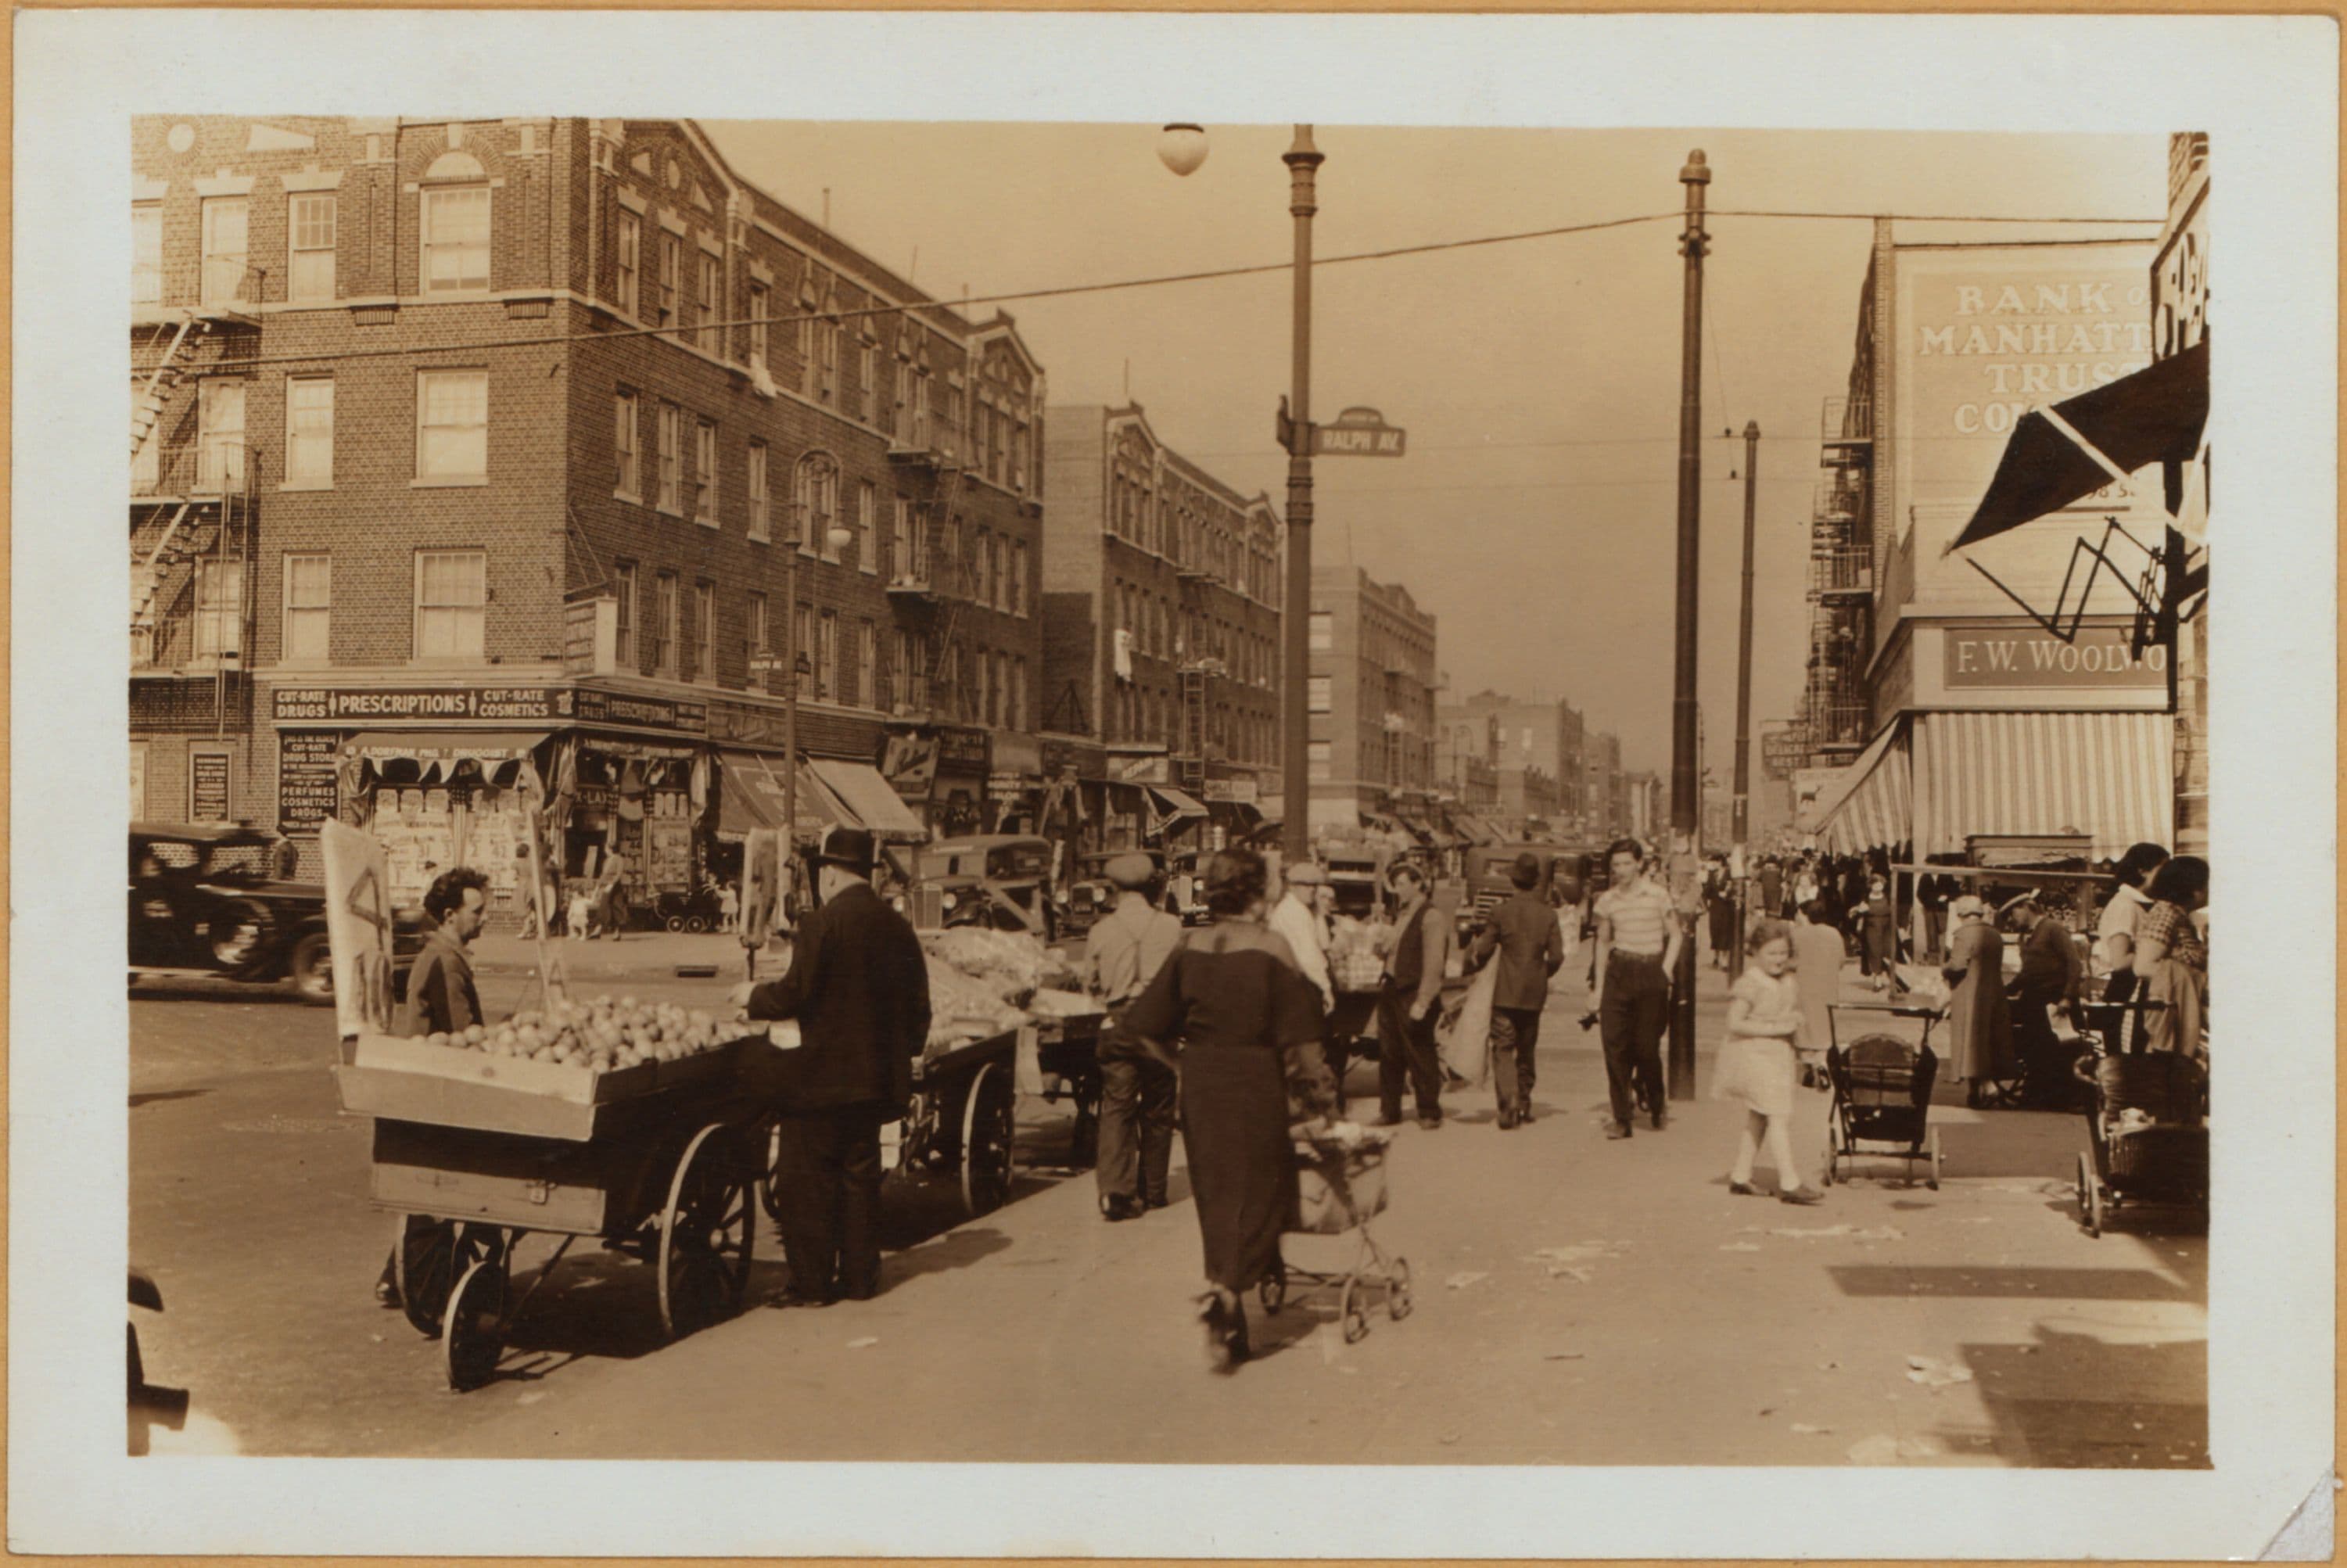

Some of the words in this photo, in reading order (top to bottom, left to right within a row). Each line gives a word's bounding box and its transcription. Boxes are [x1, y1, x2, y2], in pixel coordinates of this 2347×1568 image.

[1955, 283, 2112, 316] BANK
[2126, 285, 2149, 307] o
[1919, 322, 2152, 356] MANHATT
[1322, 430, 1372, 451] RALPH
[2028, 639, 2166, 674] WOOLWO
[276, 691, 326, 702] CUT-RATE
[483, 690, 545, 701] CUT-RATE
[339, 695, 465, 713] PRESCRIPTIONS
[479, 704, 549, 716] COSMETICS
[277, 705, 326, 717] DRUGS
[282, 752, 307, 762] DRUG
[309, 752, 336, 762] STORE
[282, 787, 336, 796] PERFUMES
[282, 798, 336, 807] COSMETICS
